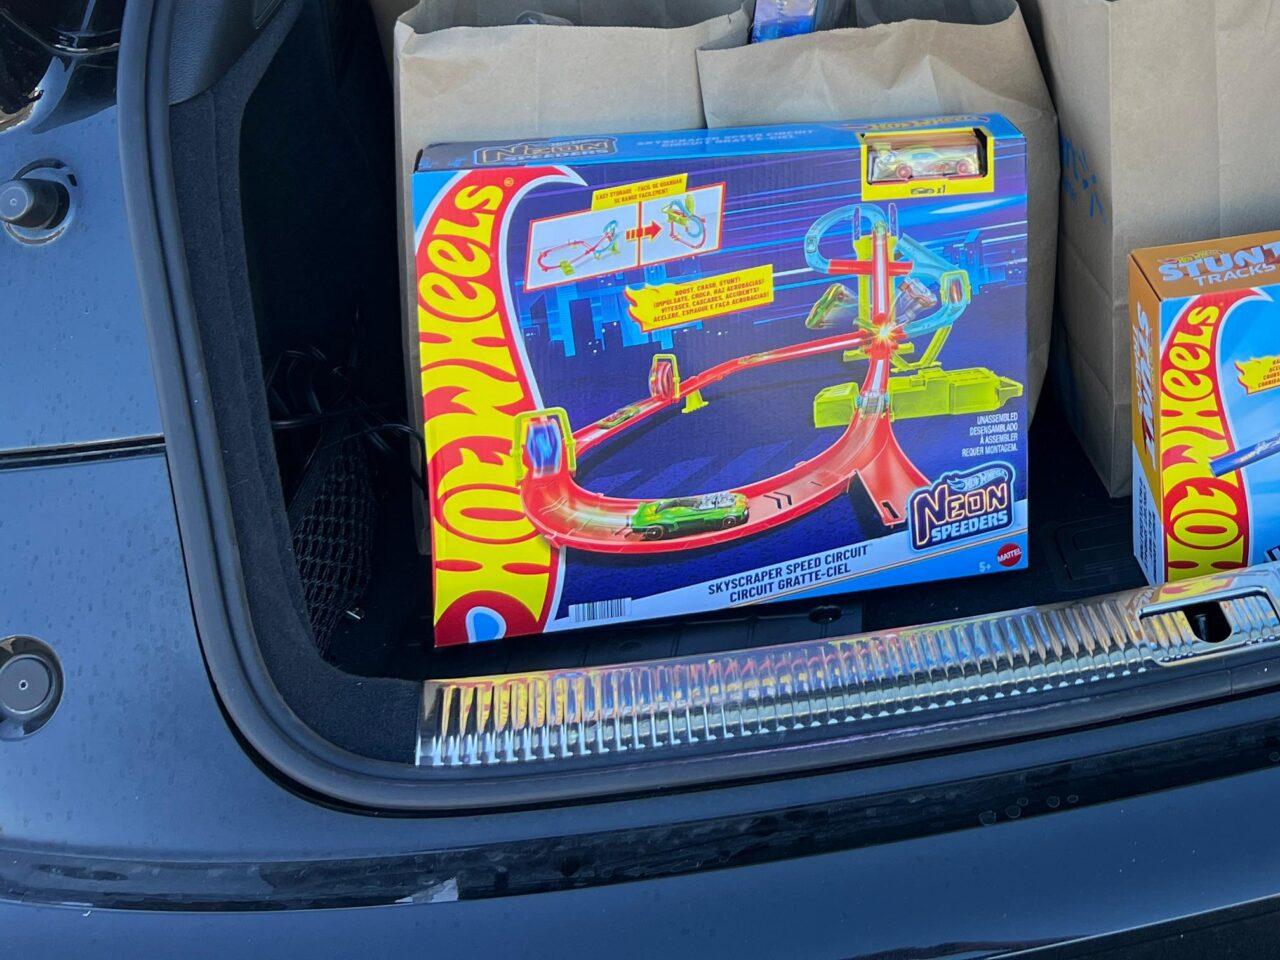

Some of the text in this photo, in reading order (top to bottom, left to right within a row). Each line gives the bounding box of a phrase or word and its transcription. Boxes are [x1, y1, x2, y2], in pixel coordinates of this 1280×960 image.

[1193, 262, 1276, 286] TRACKS
[977, 412, 1018, 425] UNASSEMBLED
[969, 423, 1018, 436] DESENSAMBLADO
[985, 432, 1018, 444] ASSEMBLER
[931, 510, 1008, 542] SPEEDERS
[997, 548, 1022, 562] MATTEL
[979, 561, 992, 572] 5+
[708, 567, 782, 595] SKYSCRAPER
[786, 557, 821, 575] SPEED
[730, 562, 851, 603] CIRCUIT GRATTE-CIEL
